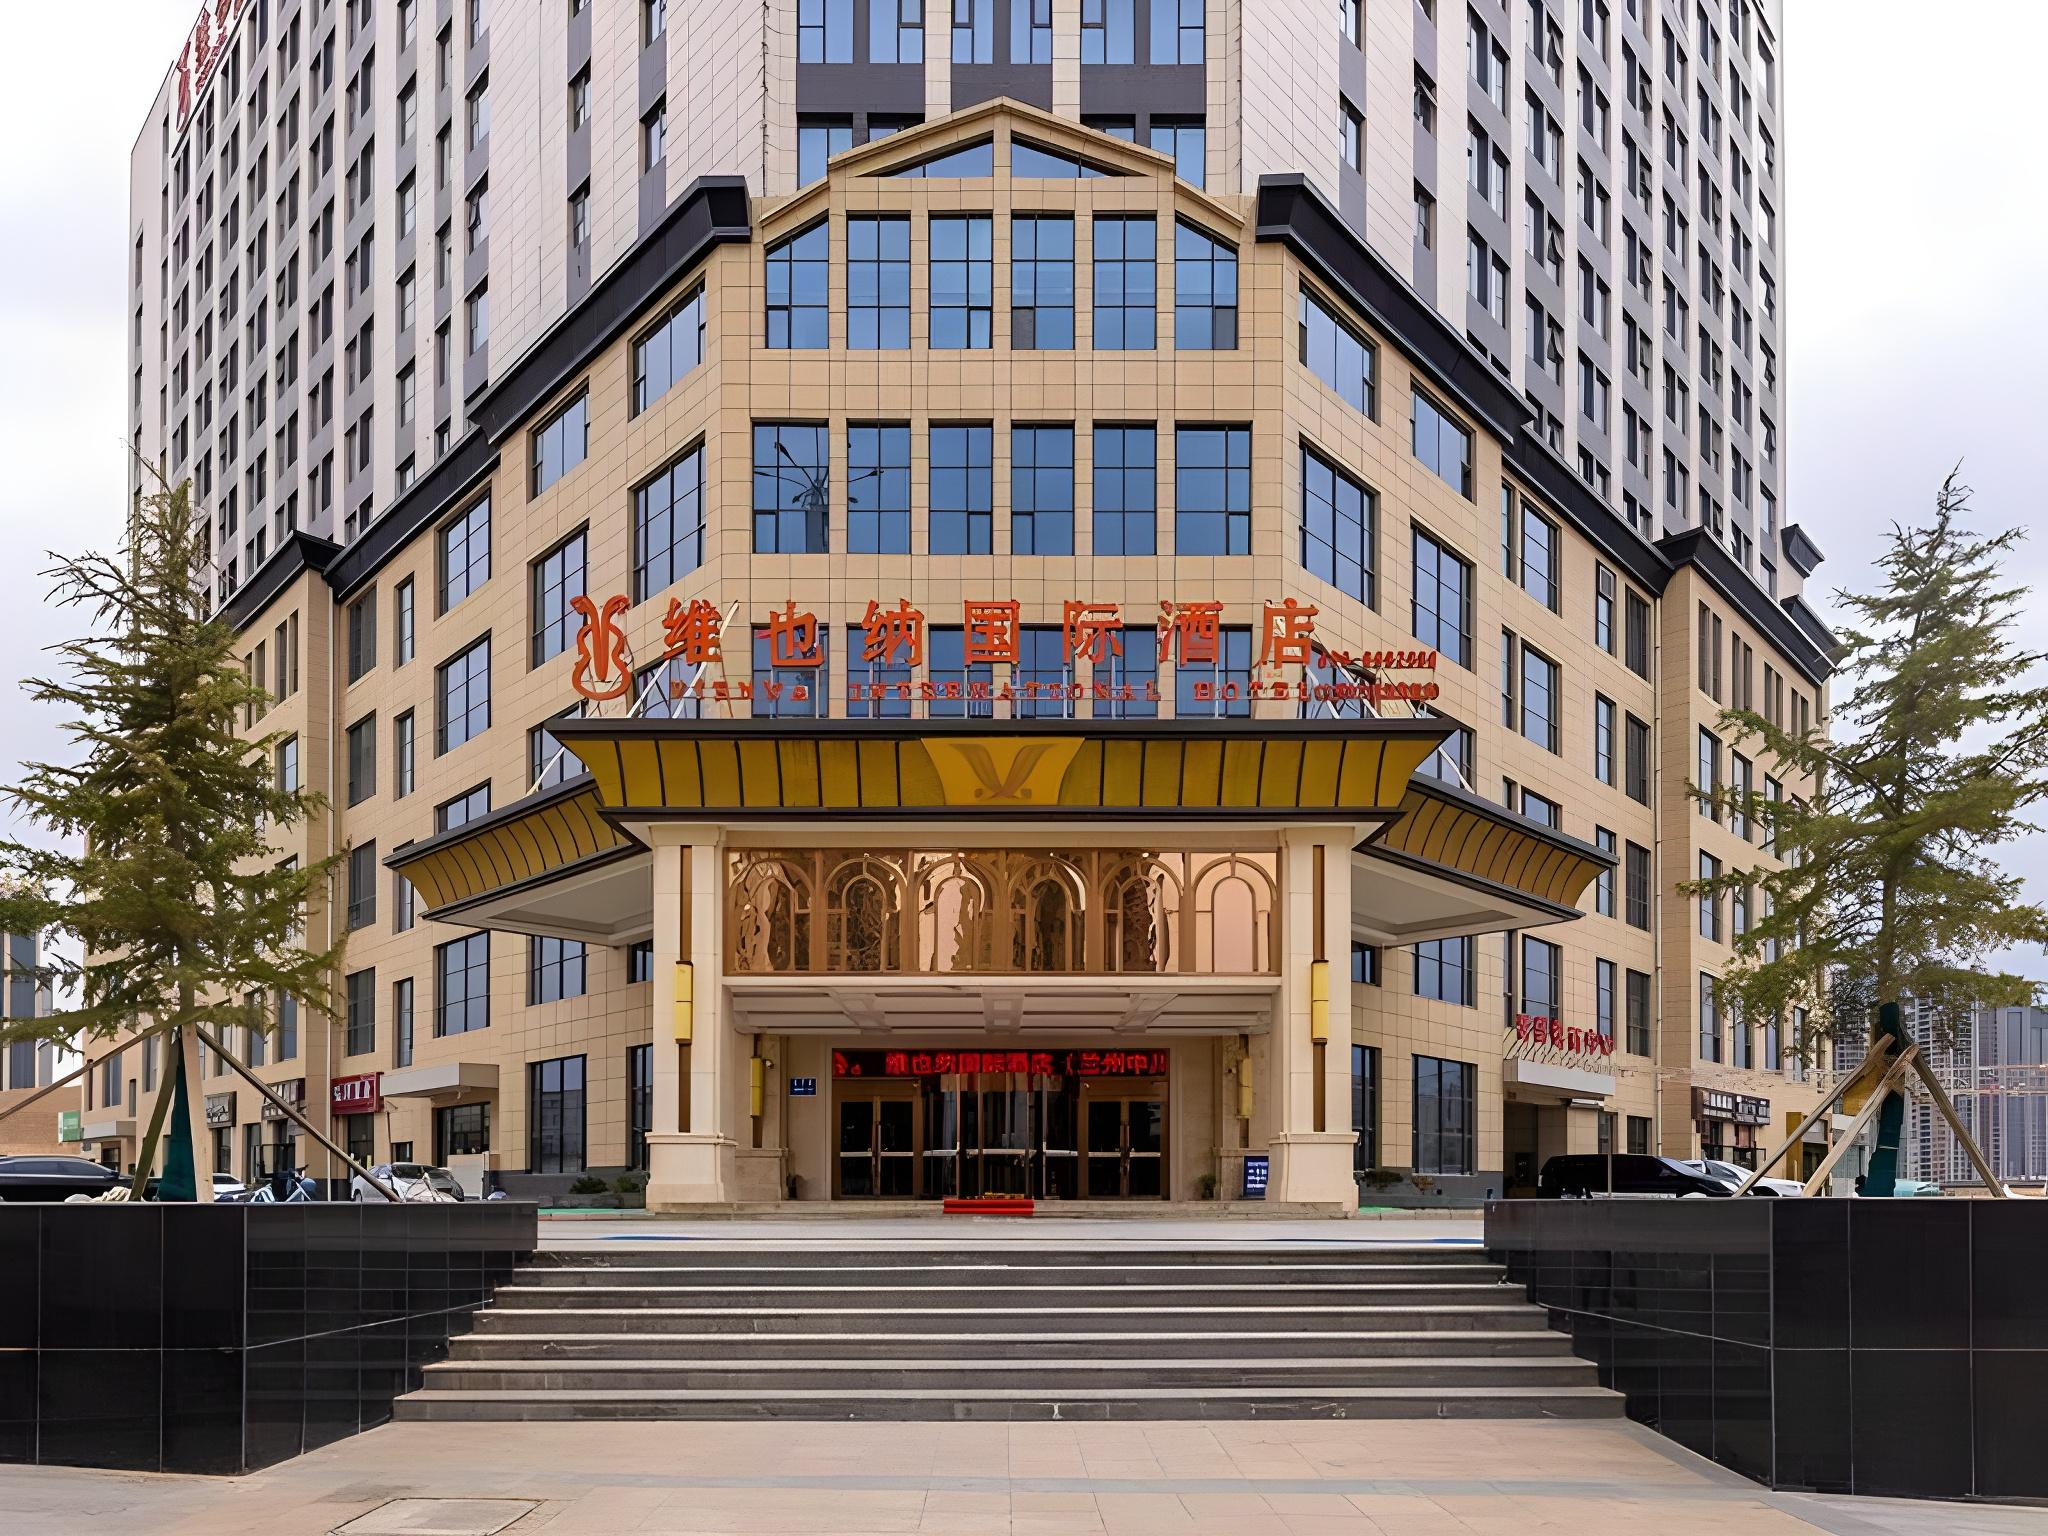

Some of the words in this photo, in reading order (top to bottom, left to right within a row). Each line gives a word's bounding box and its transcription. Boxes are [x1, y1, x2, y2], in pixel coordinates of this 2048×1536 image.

[662, 596, 1320, 669] 维也纳国际酒店
